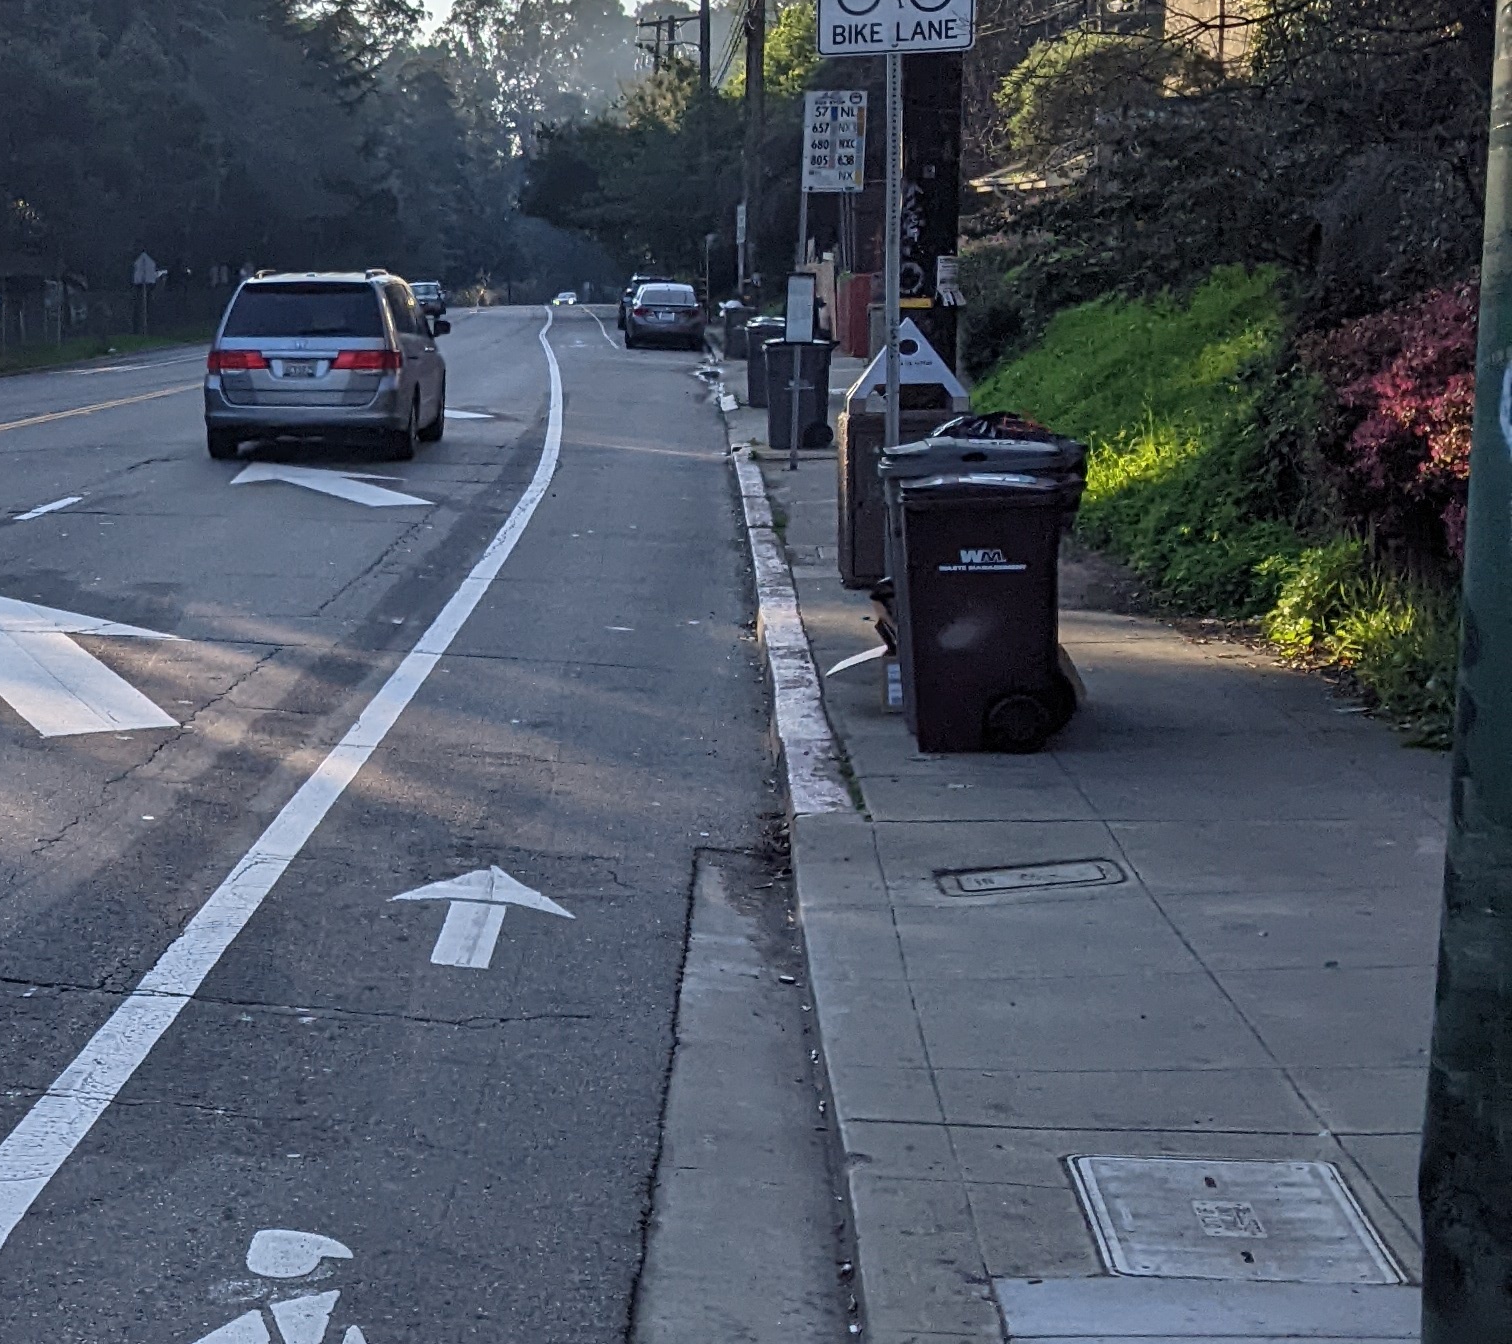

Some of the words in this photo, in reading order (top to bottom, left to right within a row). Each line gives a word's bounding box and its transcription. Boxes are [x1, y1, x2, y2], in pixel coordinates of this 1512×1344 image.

[832, 22, 884, 46] BIKE
[895, 18, 958, 42] LANE
[814, 105, 829, 118] 57
[840, 106, 856, 118] NL
[812, 122, 830, 134] 657
[811, 138, 829, 150] 680
[810, 155, 828, 166] 805
[838, 170, 854, 181] NX
[959, 549, 1005, 563] WM
